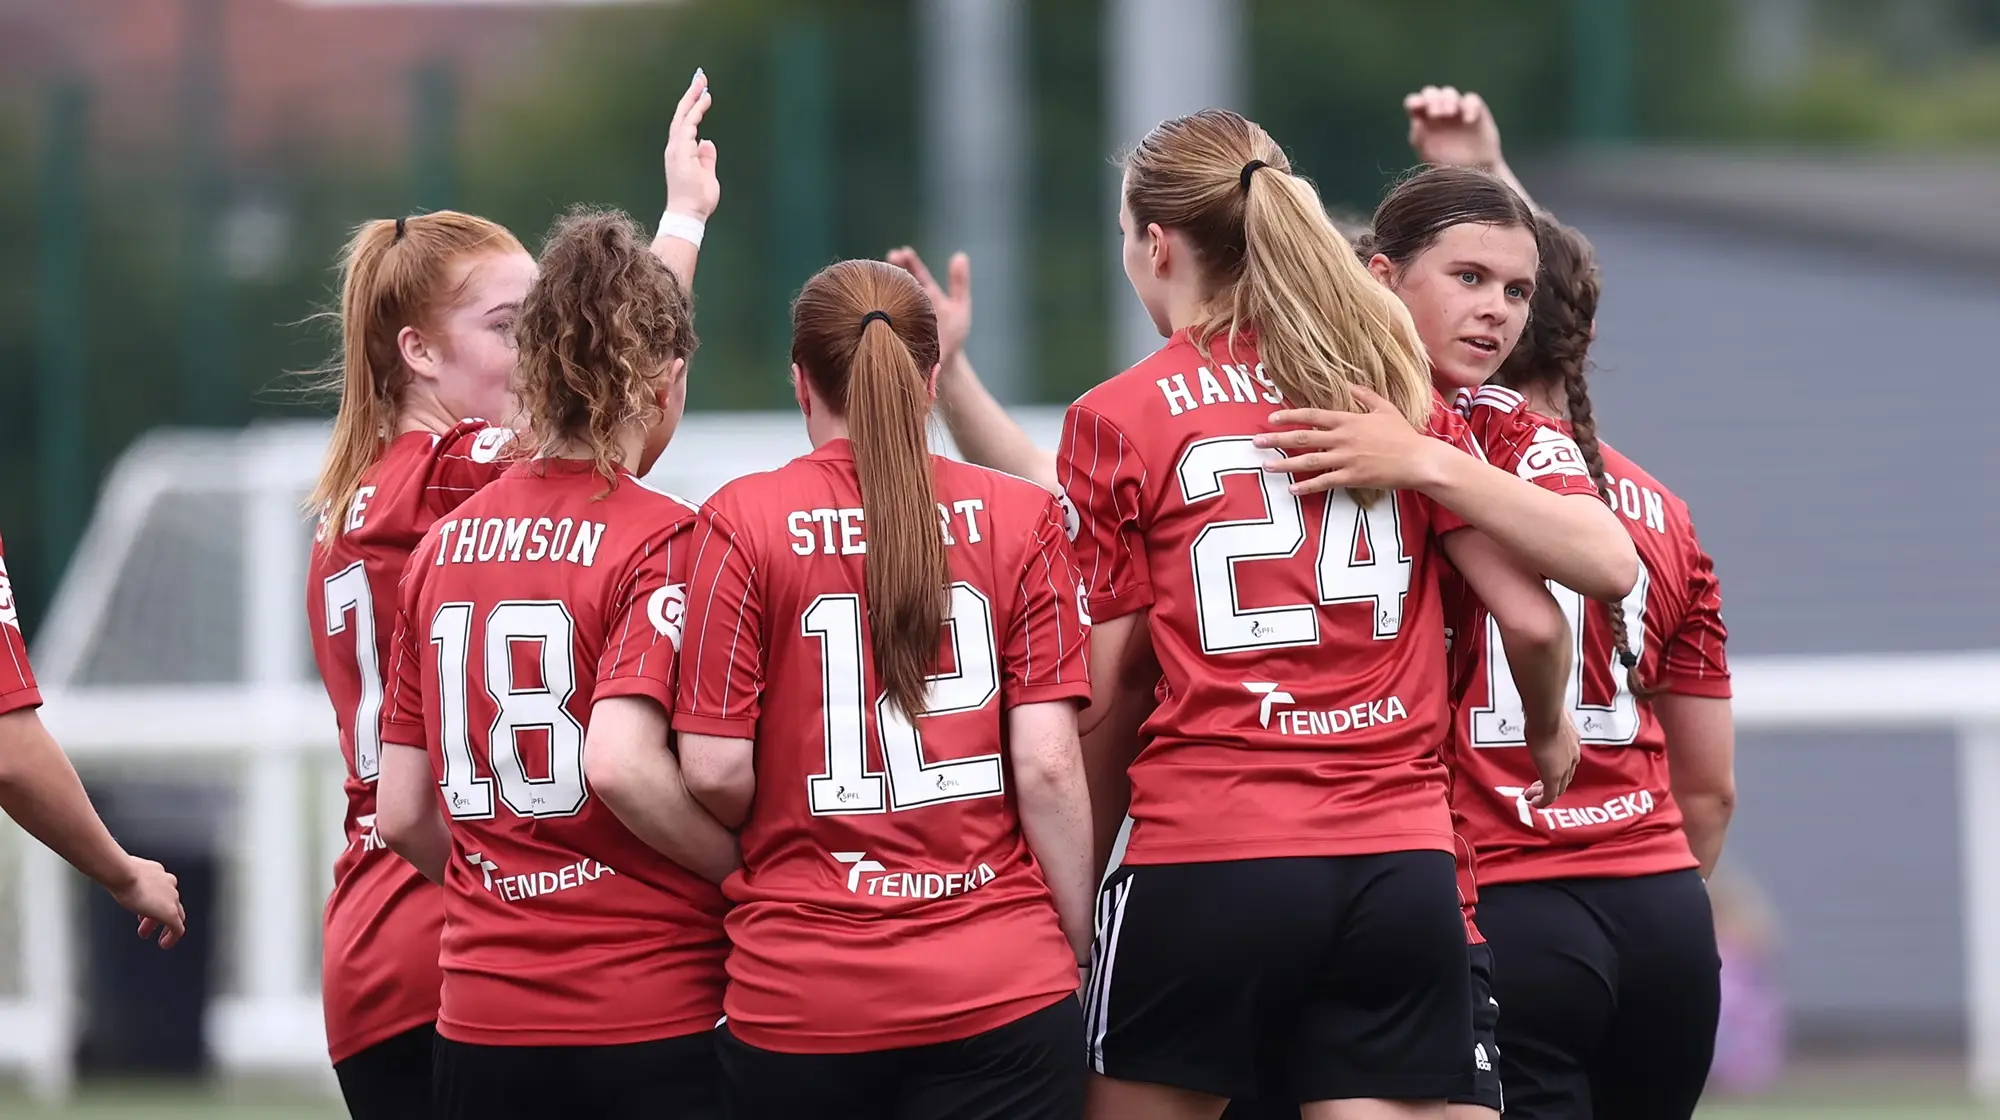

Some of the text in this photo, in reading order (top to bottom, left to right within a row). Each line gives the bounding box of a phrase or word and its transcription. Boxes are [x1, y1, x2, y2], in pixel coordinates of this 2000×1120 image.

[1157, 363, 1286, 416] HANS
[787, 498, 984, 557] STERT
[1603, 471, 1665, 534] SON
[435, 517, 606, 567] THOMSON
[1176, 436, 1412, 655] 24
[1256, 626, 1275, 635] SPFL
[324, 559, 383, 783] 7
[430, 599, 589, 820] 18
[801, 581, 1004, 816] 12
[1276, 696, 1408, 735] TENDEKA
[457, 798, 471, 806] SPFL
[842, 792, 860, 800] SPFL
[1537, 790, 1654, 830] TENDEKA
[494, 858, 616, 902] TENDEKA
[866, 862, 996, 899] TENDEKA
